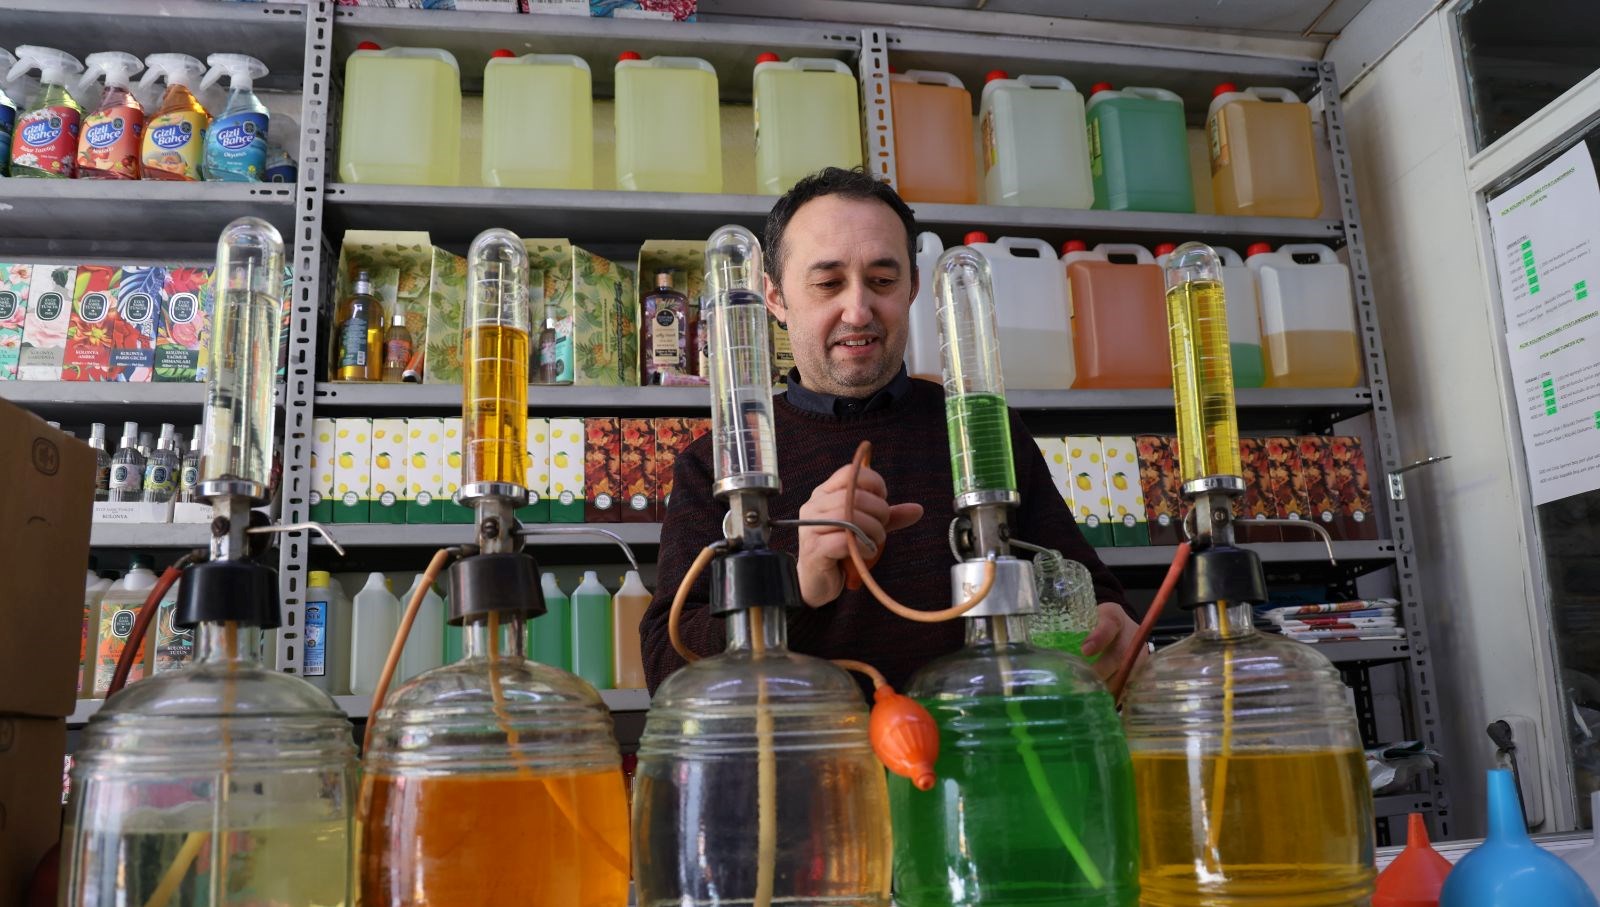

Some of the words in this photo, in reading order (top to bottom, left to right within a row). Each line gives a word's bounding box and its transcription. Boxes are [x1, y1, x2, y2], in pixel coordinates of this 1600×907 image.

[24, 123, 45, 135] Gizli
[88, 125, 108, 137] Gizli
[154, 127, 176, 138] Gizli
[218, 128, 240, 139] Gizli
[28, 129, 59, 142] Bahçe
[91, 131, 121, 143] Bahçe
[158, 134, 189, 145] Bahçe
[223, 135, 253, 146] Bahçe
